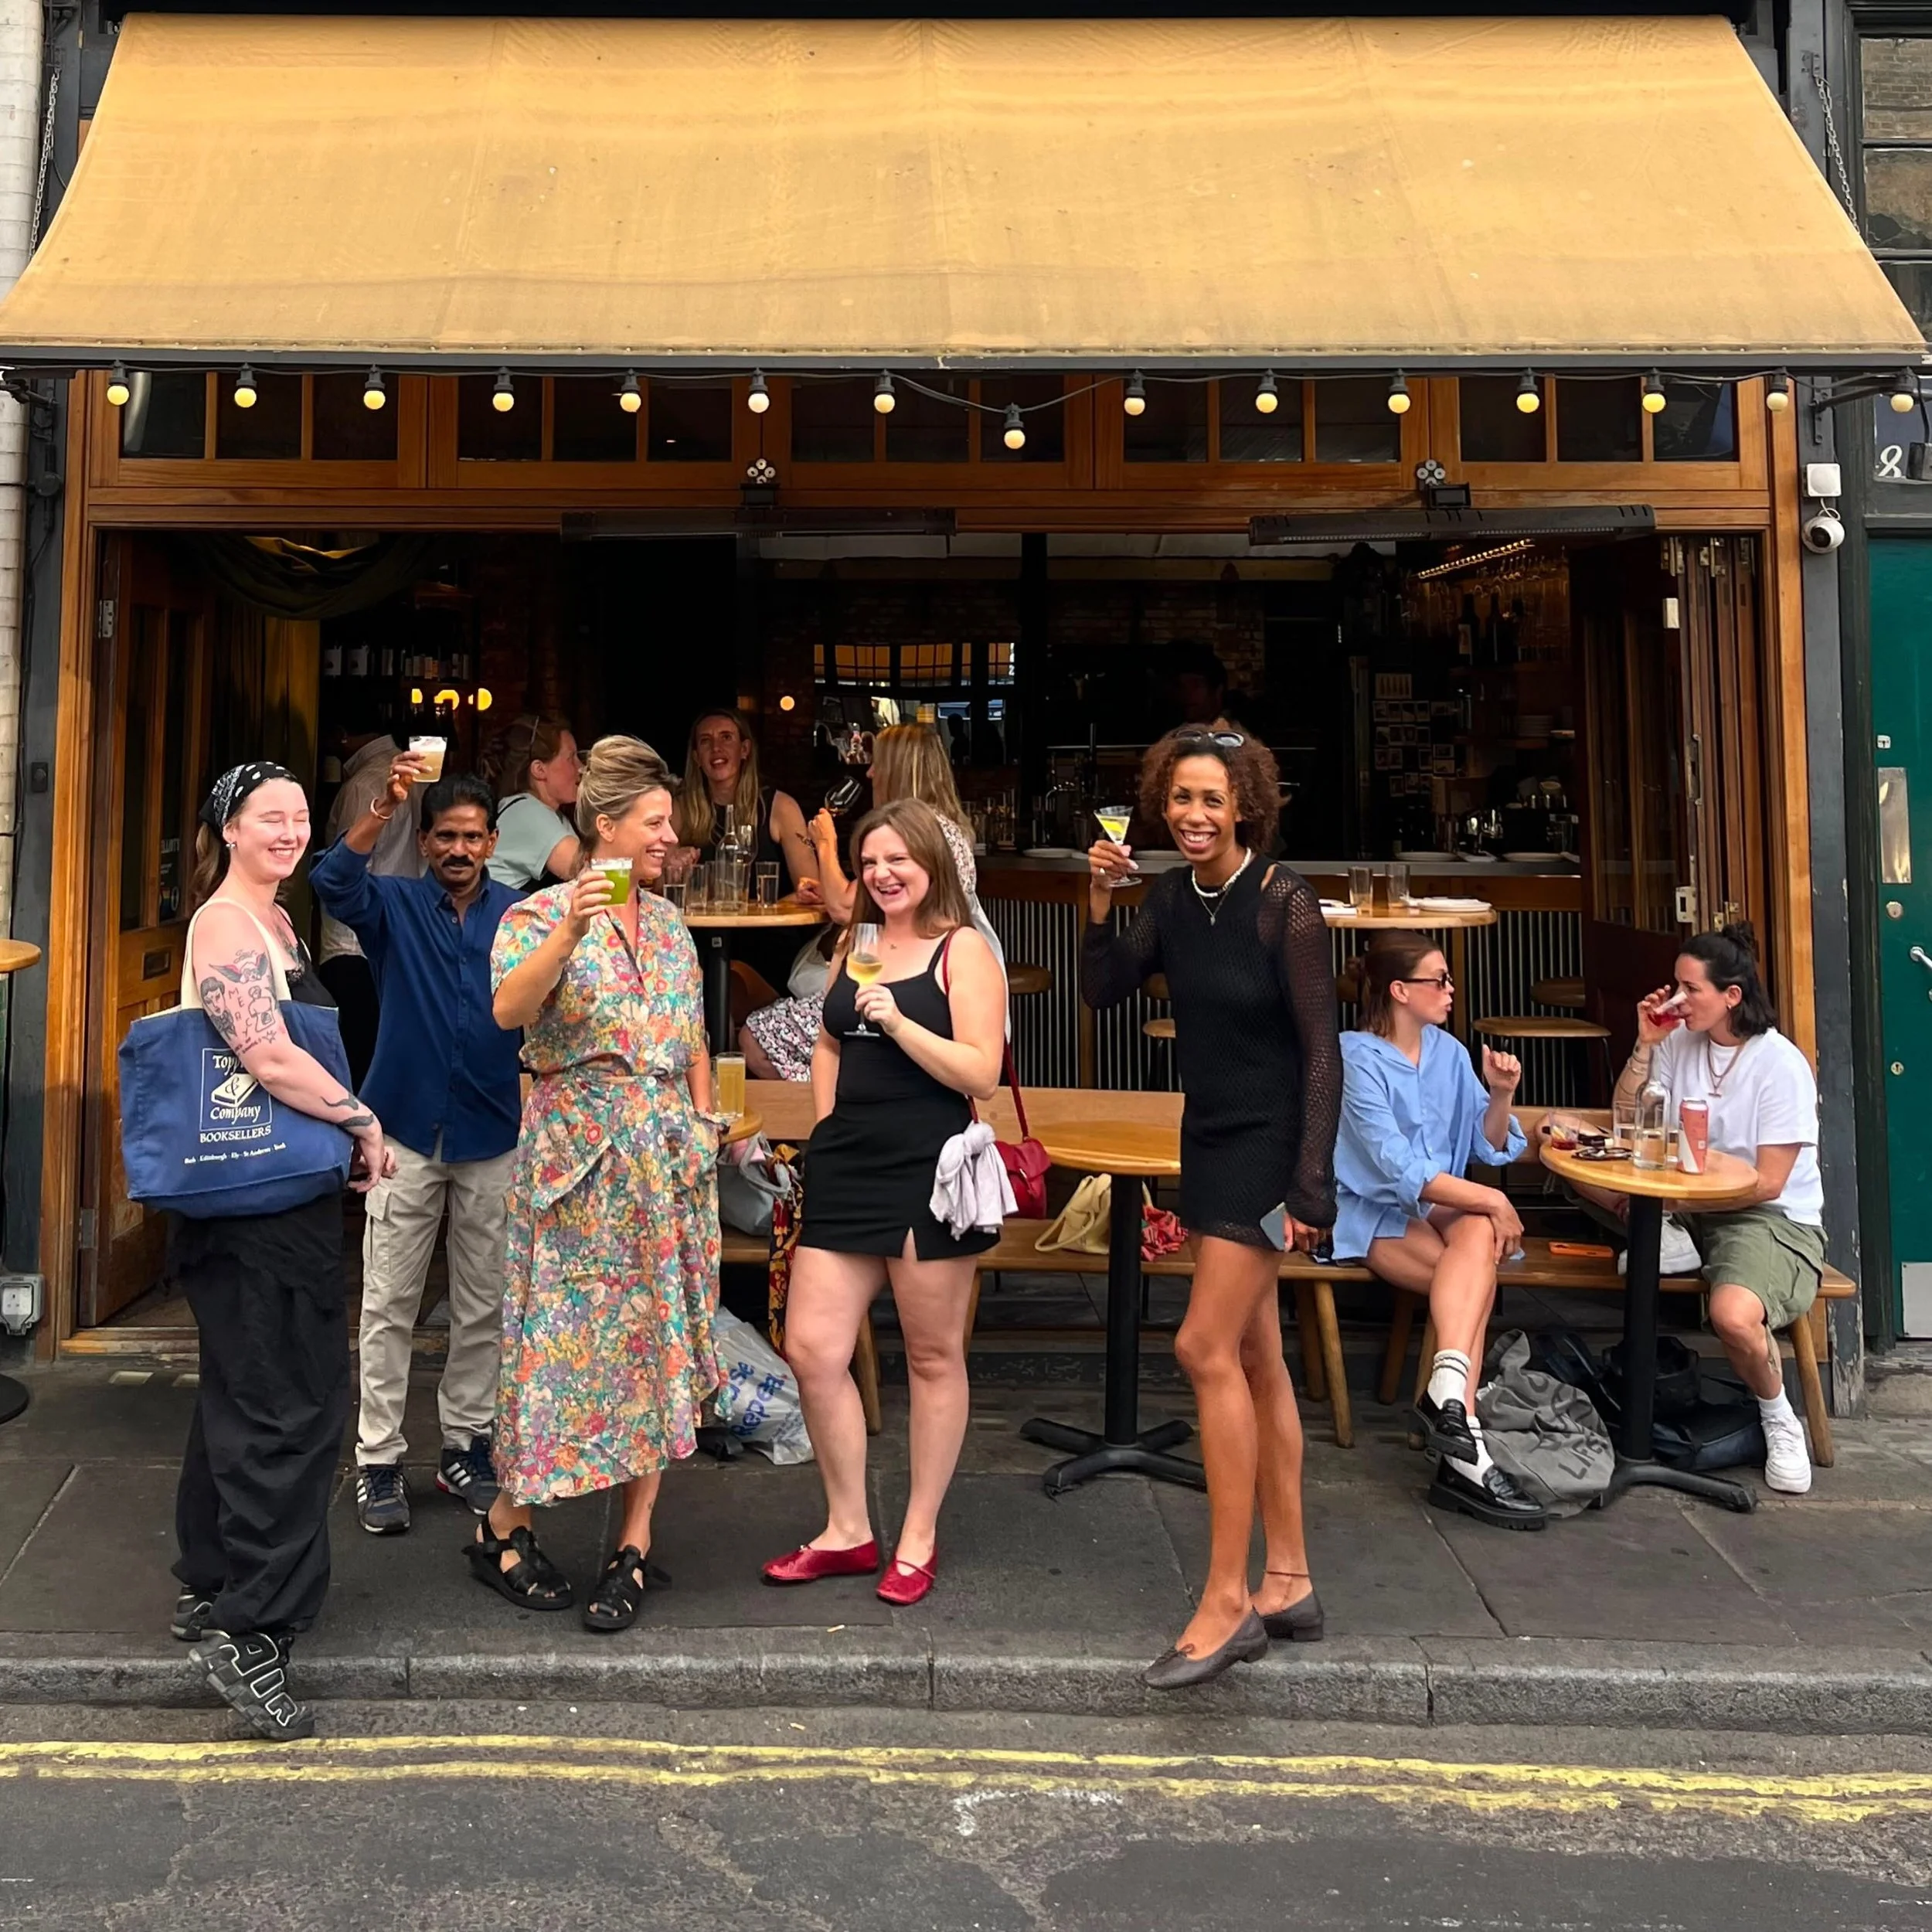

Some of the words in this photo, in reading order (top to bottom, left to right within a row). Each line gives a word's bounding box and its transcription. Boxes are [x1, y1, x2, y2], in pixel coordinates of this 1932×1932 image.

[213, 1055, 243, 1076] Topp
[225, 1077, 240, 1096] &
[210, 1105, 261, 1125] Company
[199, 1125, 271, 1143] BOOKSELLERS
[219, 1633, 298, 1726] AIR
